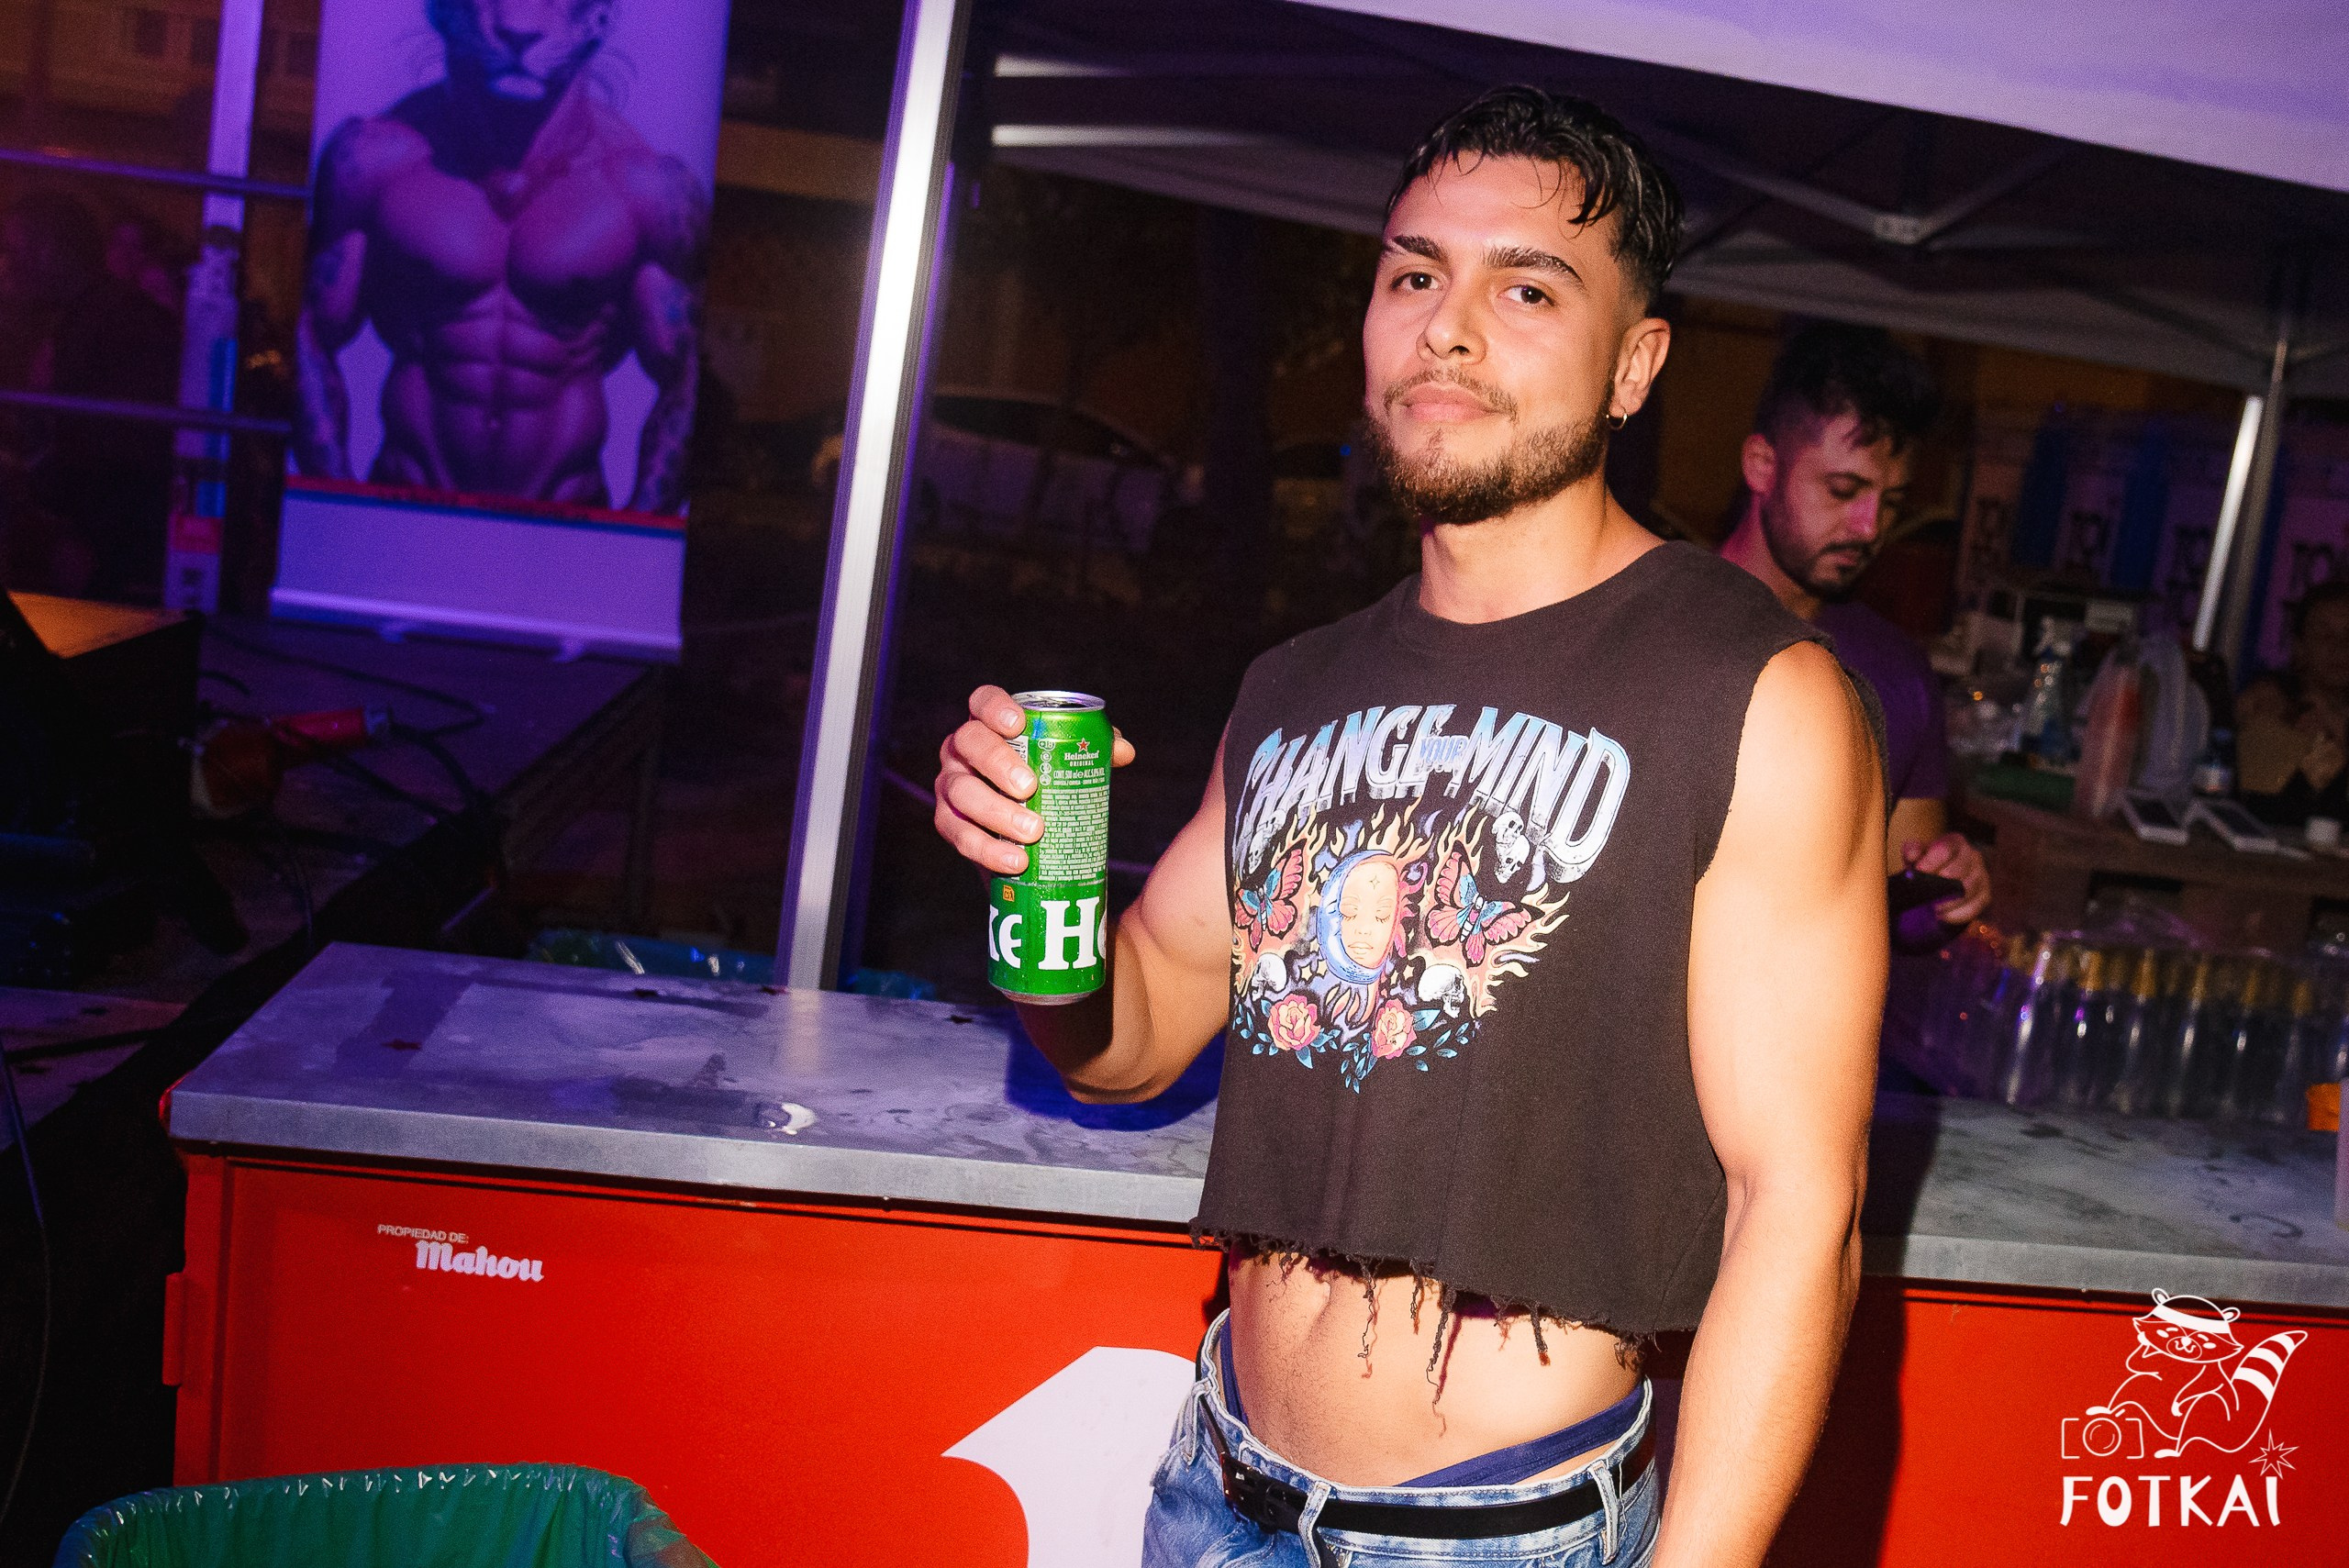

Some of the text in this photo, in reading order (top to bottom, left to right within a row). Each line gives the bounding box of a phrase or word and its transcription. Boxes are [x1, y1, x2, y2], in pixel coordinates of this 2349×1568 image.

[1064, 751, 1099, 761] Heineken
[1232, 704, 1457, 872] CHANGE
[1443, 706, 1631, 884] MIND
[377, 1224, 470, 1244] PROPIEDAD DE:
[415, 1240, 544, 1283] Mahou
